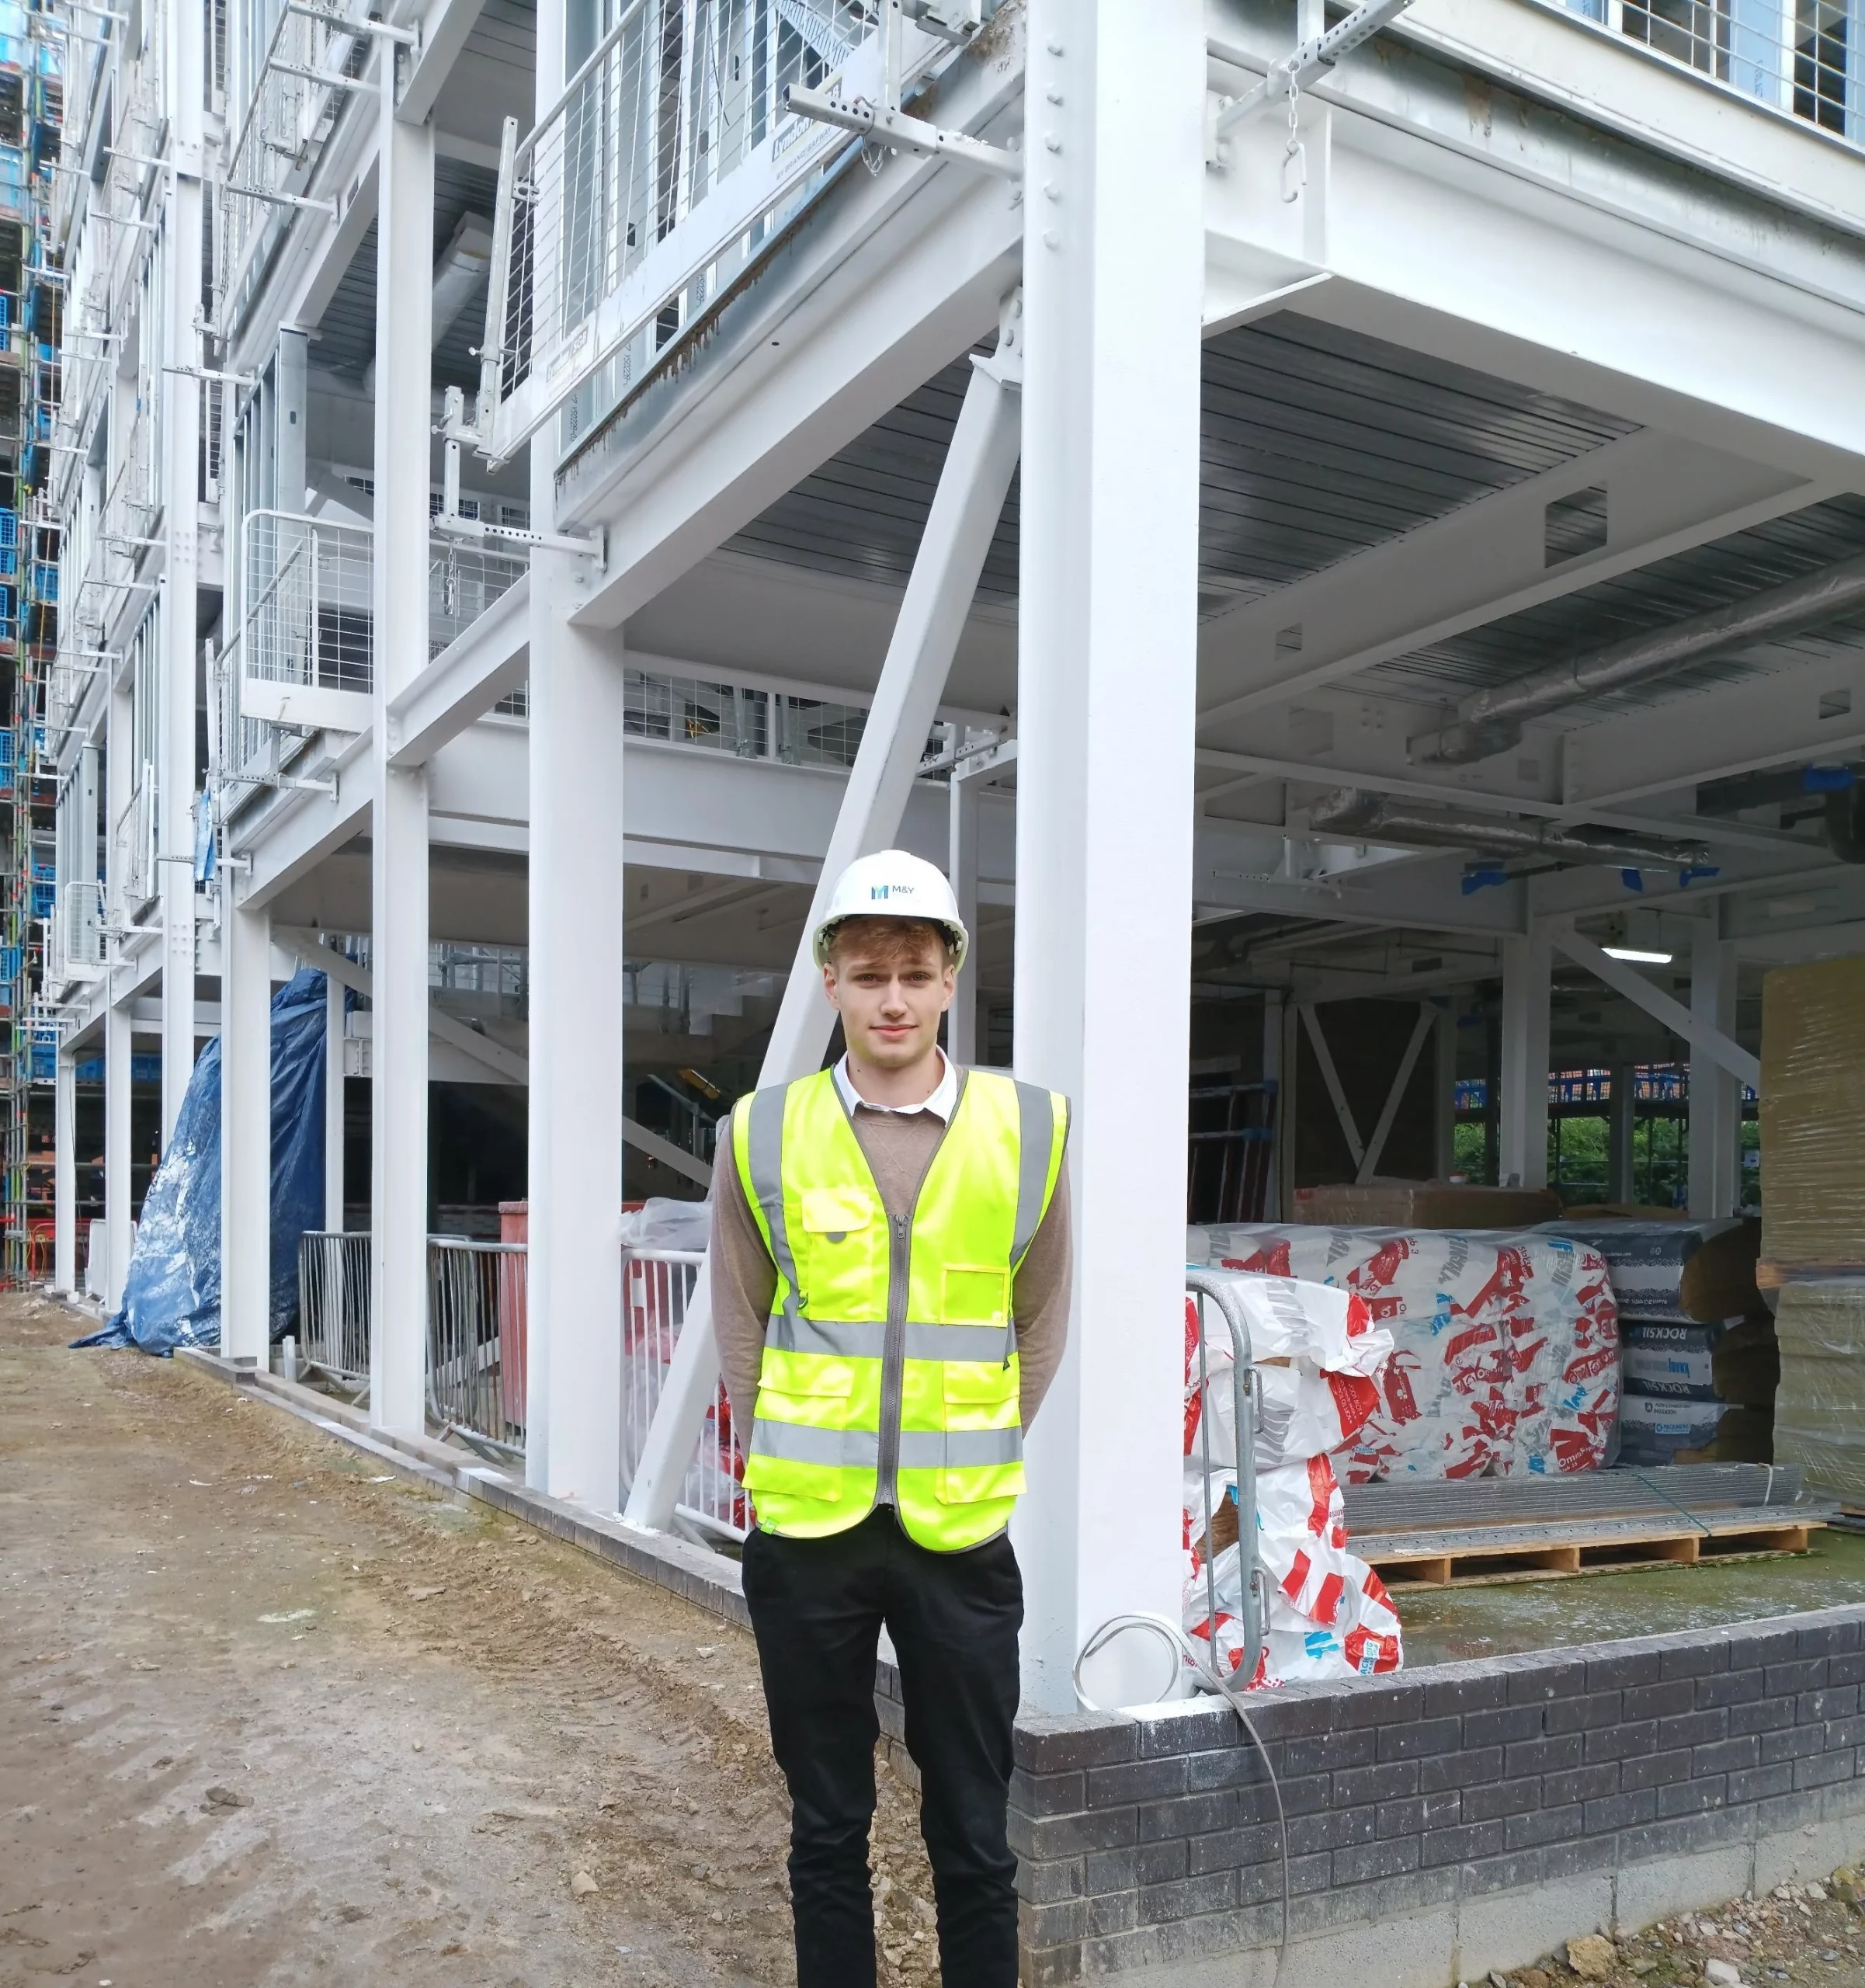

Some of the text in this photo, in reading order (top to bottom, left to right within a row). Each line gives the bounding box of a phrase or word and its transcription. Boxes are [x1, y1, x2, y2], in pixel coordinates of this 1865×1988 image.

[892, 885, 915, 894] M&Y
[1642, 1327, 1687, 1340] ROCKSIL
[1643, 1381, 1692, 1395] ROCKSIL
